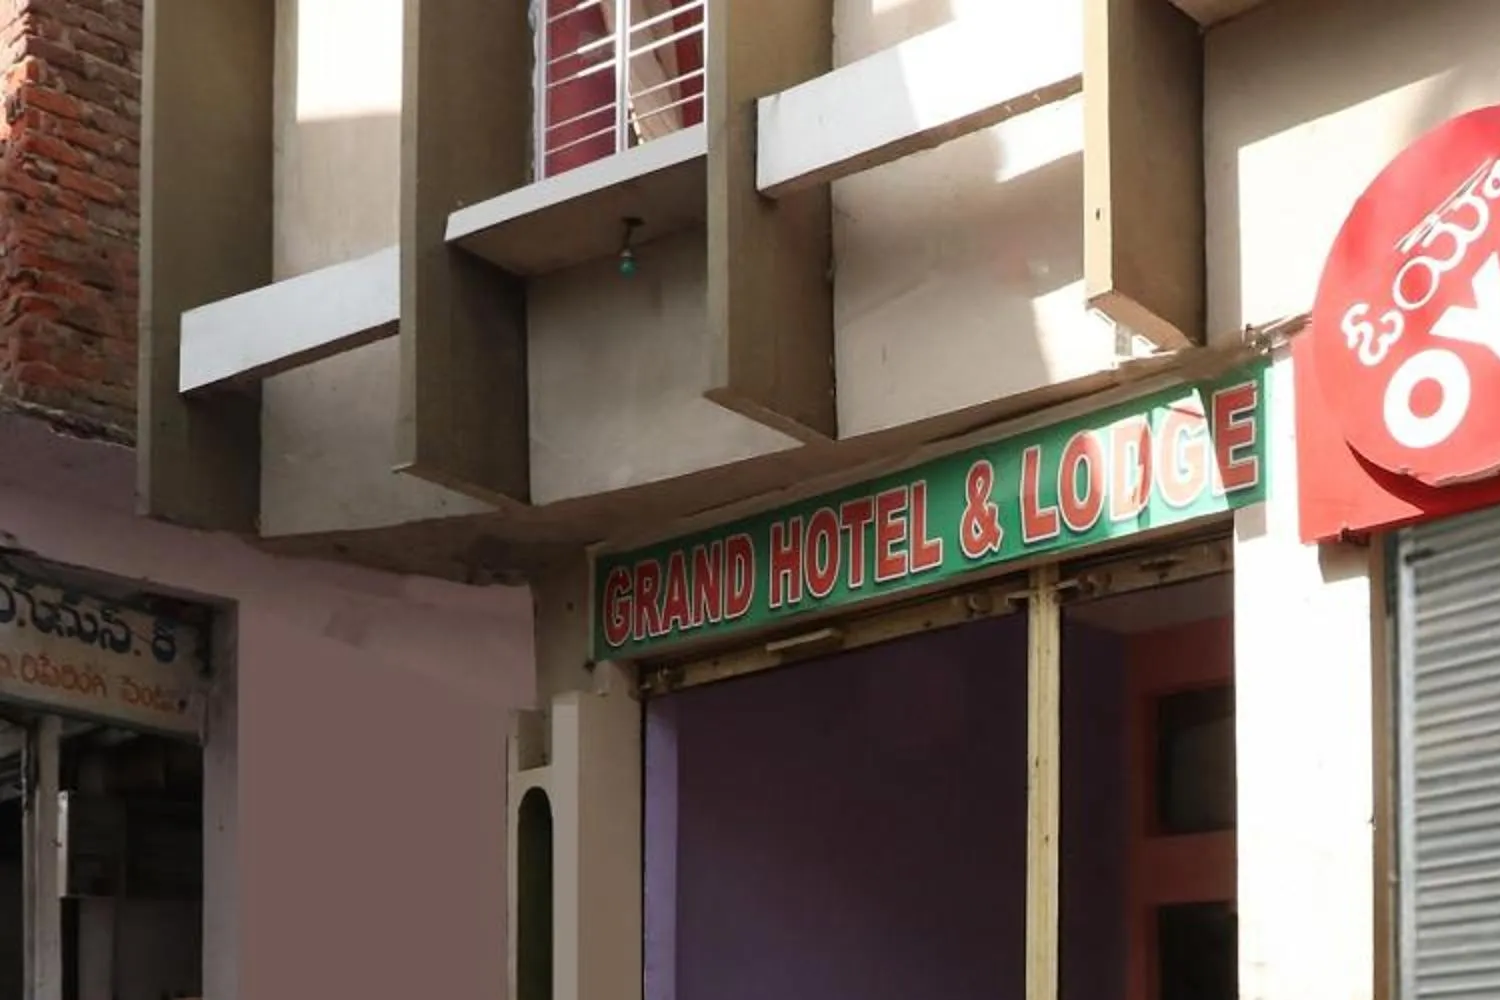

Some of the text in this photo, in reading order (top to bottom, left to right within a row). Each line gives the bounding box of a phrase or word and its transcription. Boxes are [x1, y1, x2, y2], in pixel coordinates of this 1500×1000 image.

[602, 380, 1259, 648] GRAND HOTEL & LODGE
